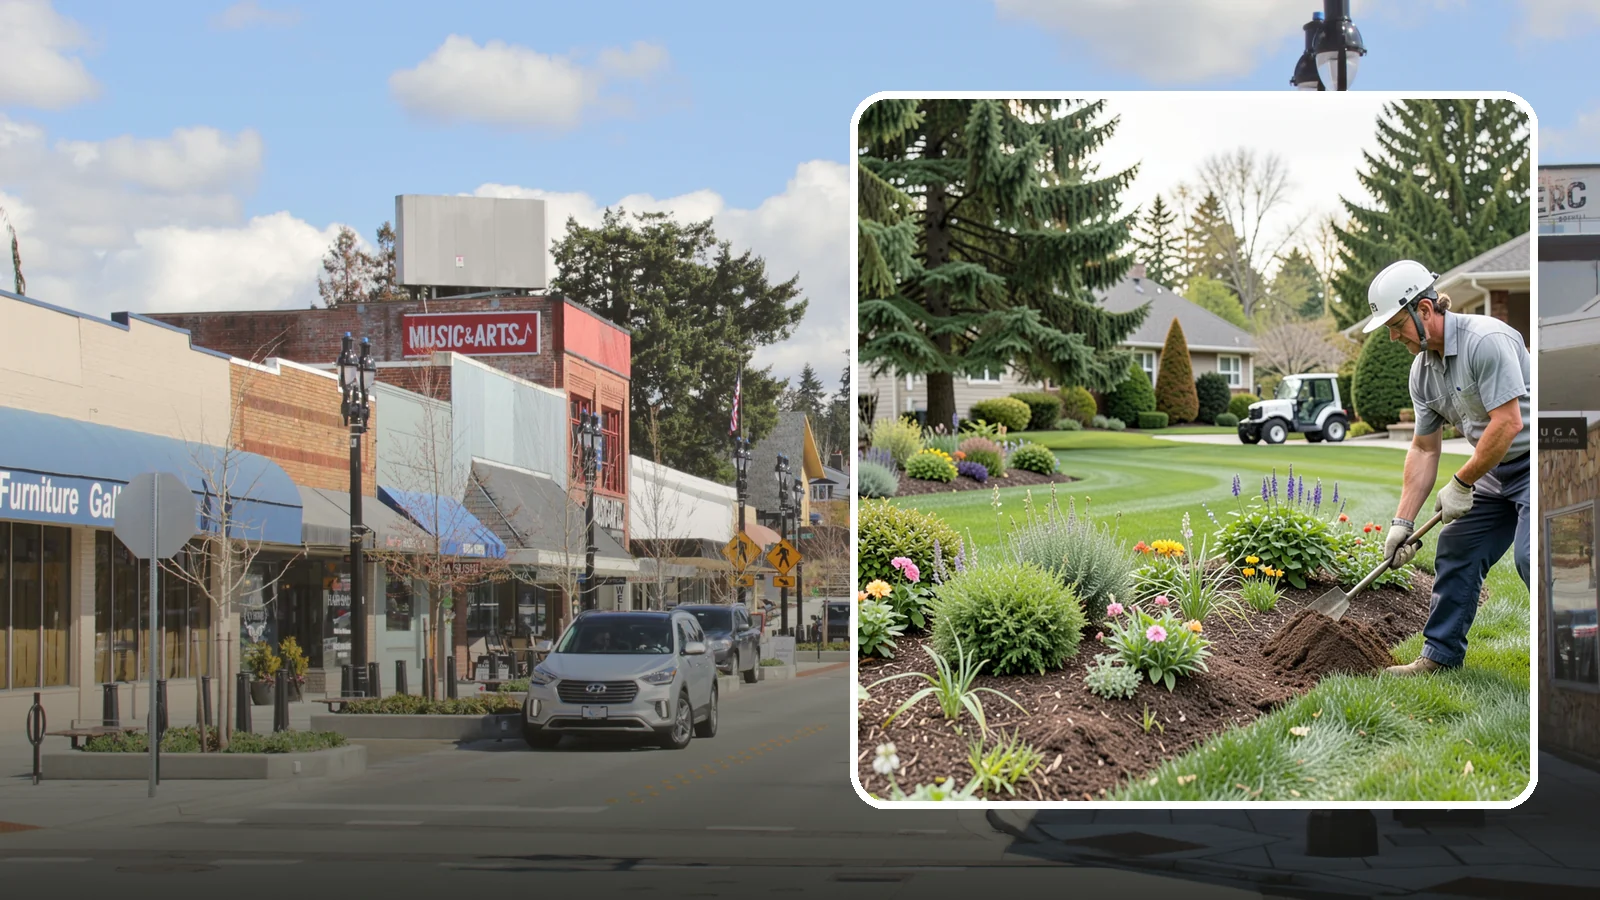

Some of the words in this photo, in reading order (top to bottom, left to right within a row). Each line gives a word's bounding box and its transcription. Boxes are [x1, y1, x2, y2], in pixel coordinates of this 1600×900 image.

[409, 323, 519, 348] MUSIC&ARTS
[0, 472, 79, 515] Furniture
[89, 483, 122, 519] Gal
